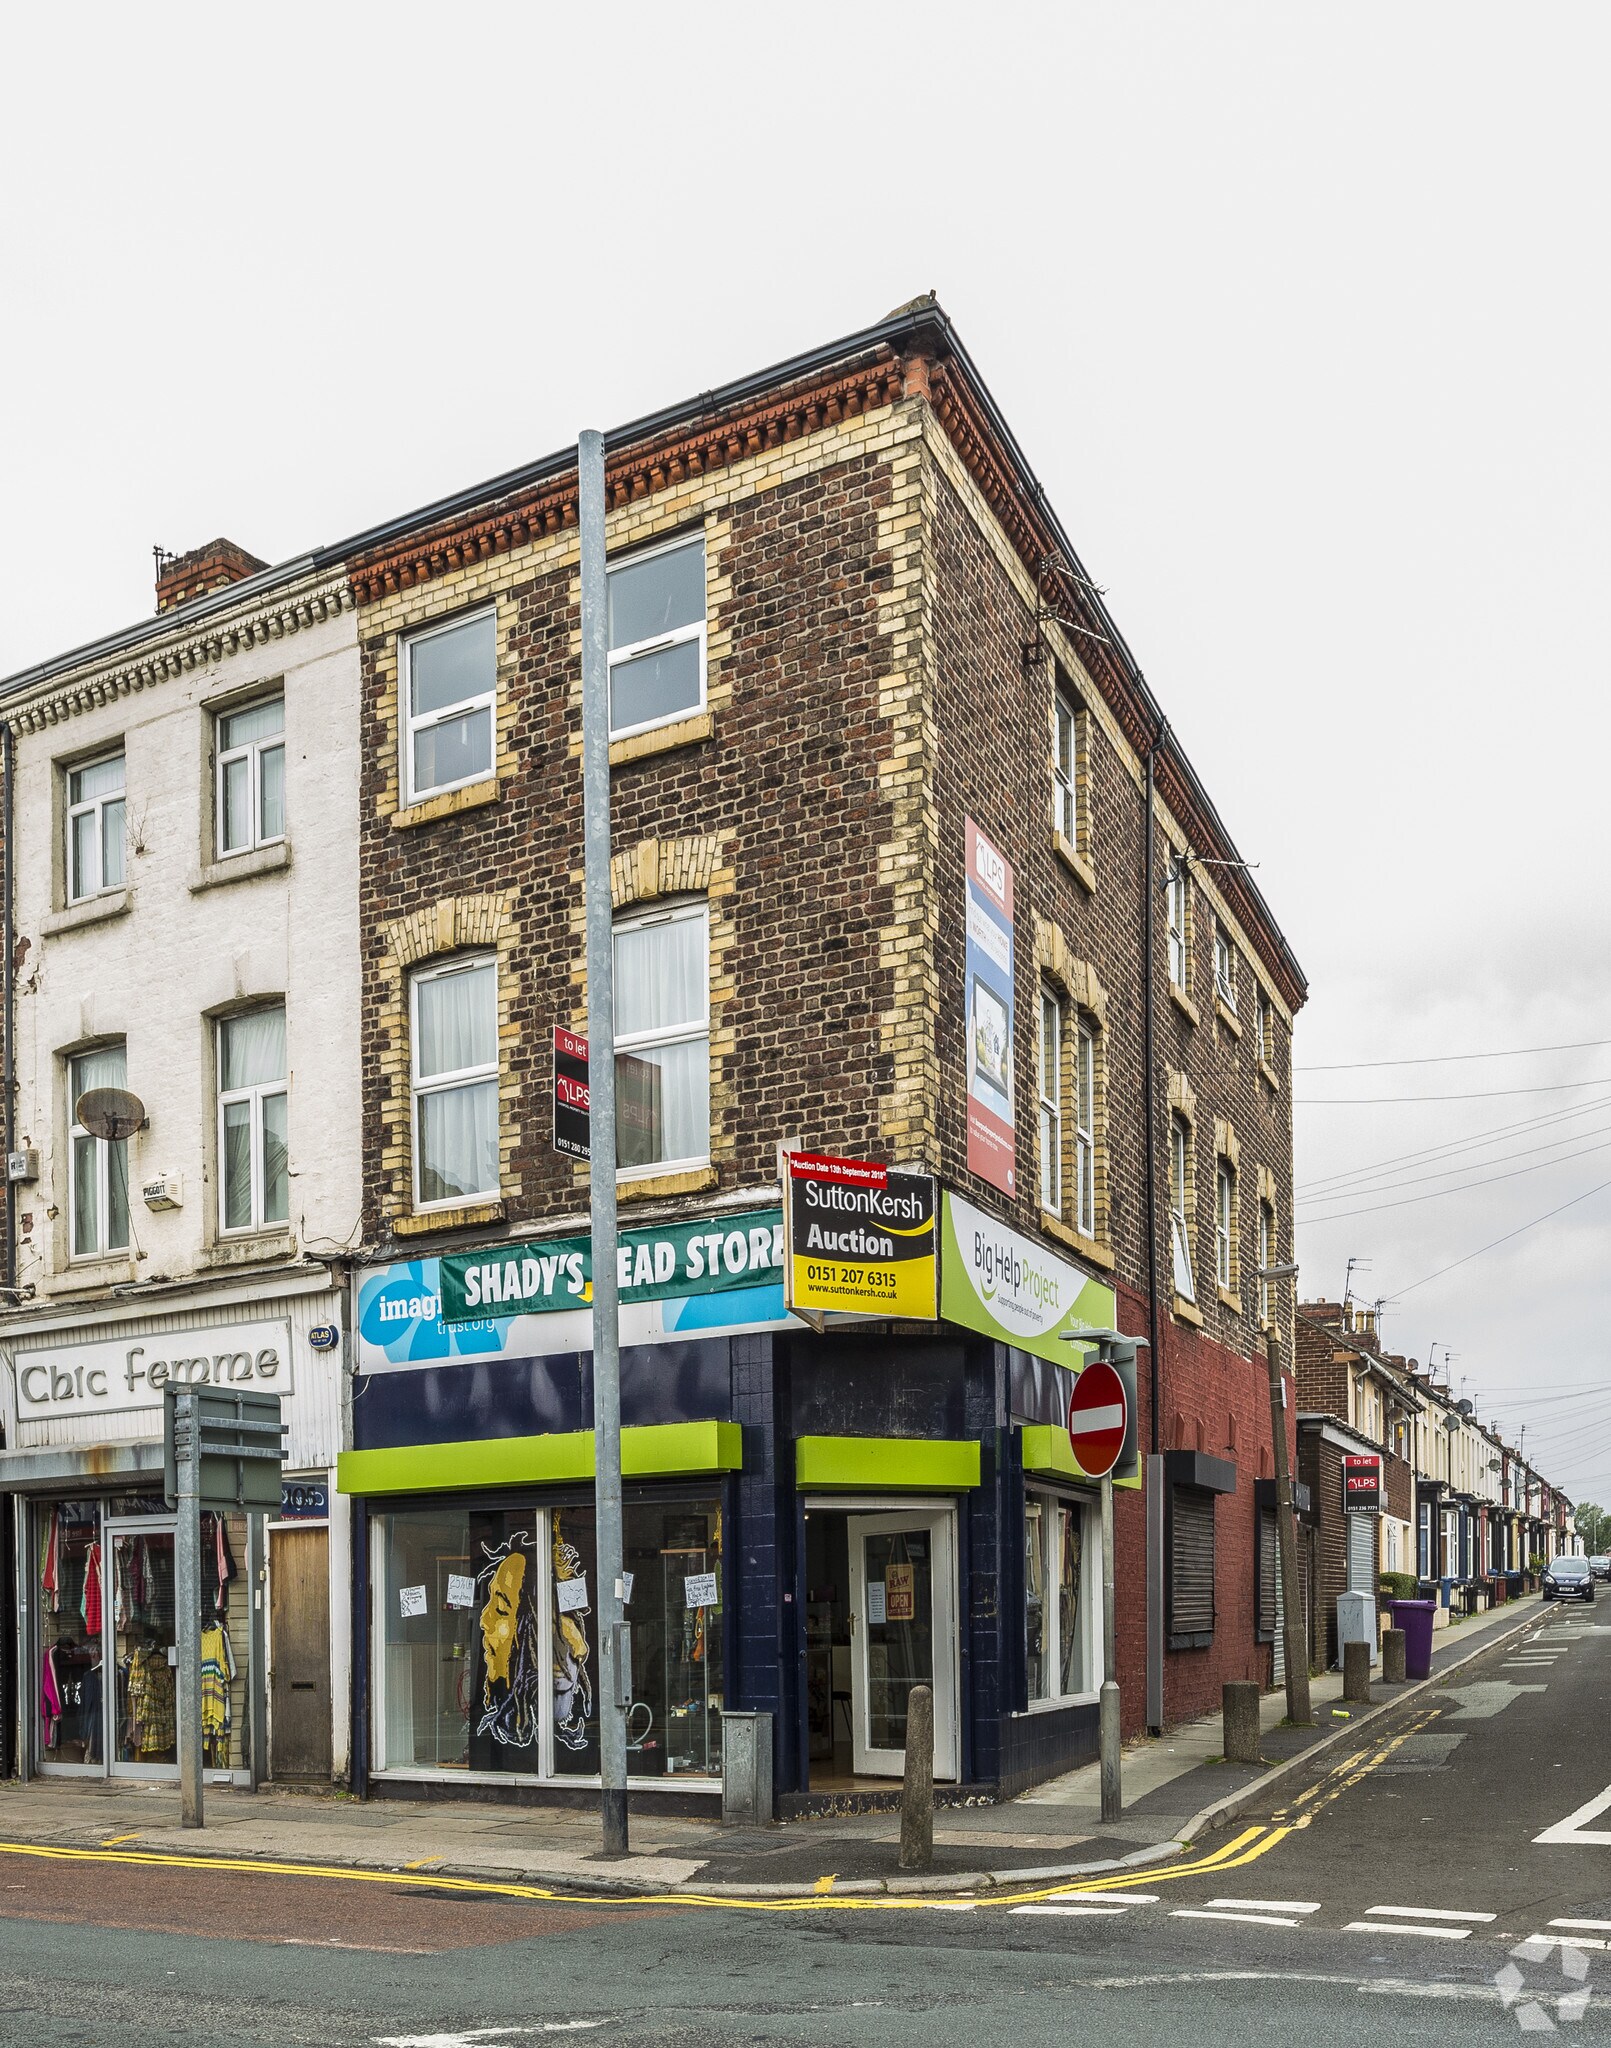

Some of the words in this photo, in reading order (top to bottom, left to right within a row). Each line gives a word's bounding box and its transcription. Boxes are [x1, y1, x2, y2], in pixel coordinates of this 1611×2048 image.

[563, 1036, 574, 1051] to
[575, 1040, 587, 1057] let
[569, 1082, 591, 1106] LPS
[557, 1137, 570, 1150] 0151
[571, 1141, 581, 1153] 280
[816, 1162, 829, 1172] Date
[829, 1163, 842, 1174] 13th
[842, 1166, 871, 1178] September
[805, 1180, 923, 1220] SuttonKersh
[807, 1223, 894, 1257] Auction
[464, 1252, 585, 1307] SHADY'S
[617, 1242, 676, 1289] EAD
[686, 1226, 785, 1279] STORE
[807, 1265, 836, 1281] 0151
[841, 1268, 864, 1284] 207
[867, 1271, 897, 1287] 6315
[974, 1231, 993, 1285] Big
[994, 1243, 1021, 1297] Help
[1022, 1258, 1060, 1309] Project
[807, 1284, 898, 1299] www.suttonkersh.co.uk
[311, 1330, 330, 1339] ATLAS
[20, 1365, 109, 1403] Chic
[124, 1347, 280, 1392] femme
[1363, 1457, 1372, 1465] let
[1357, 1478, 1375, 1487] LPS
[890, 1594, 909, 1608] OPEN
